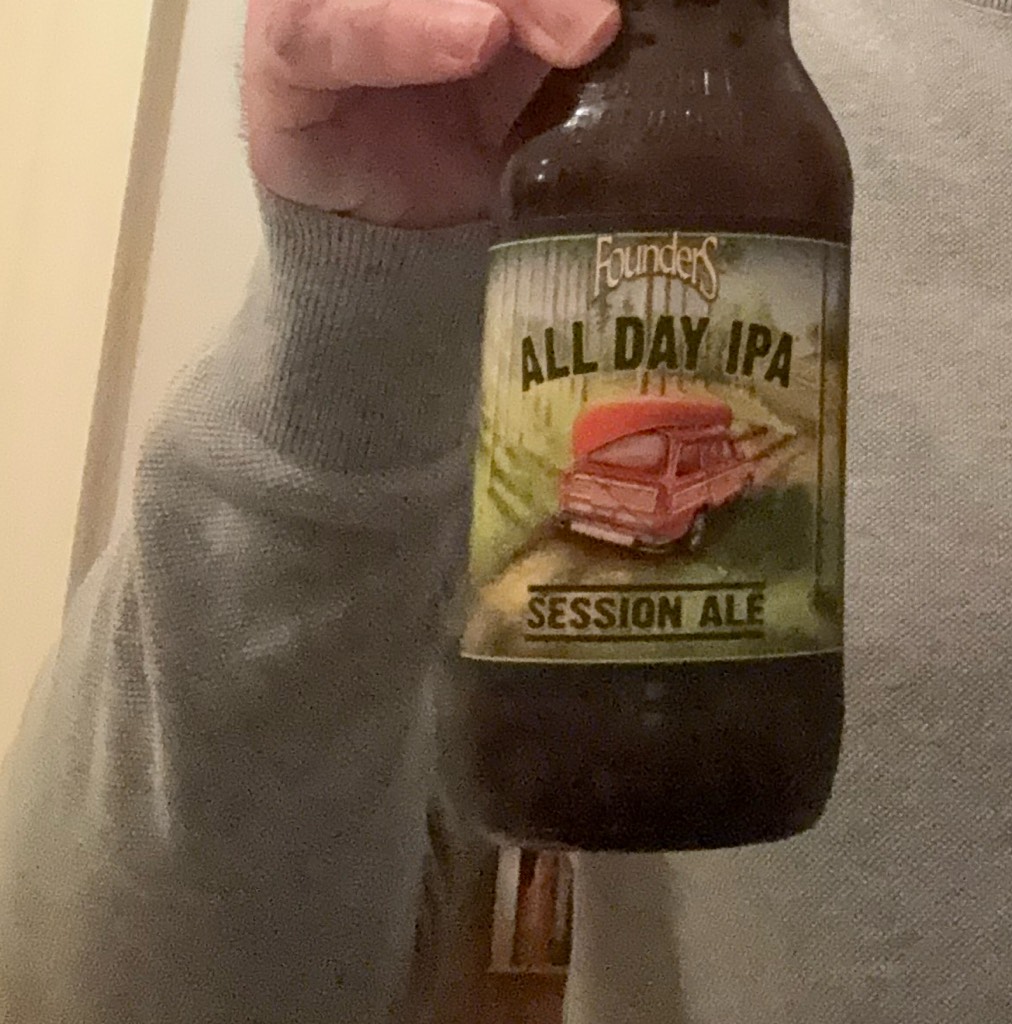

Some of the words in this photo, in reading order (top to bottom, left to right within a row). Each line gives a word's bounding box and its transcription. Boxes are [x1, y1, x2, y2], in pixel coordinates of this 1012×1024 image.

[521, 320, 598, 392] ALL
[613, 315, 710, 370] DAY
[724, 320, 794, 388] IPA
[526, 592, 682, 630] SESSION
[700, 593, 764, 627] ALE
